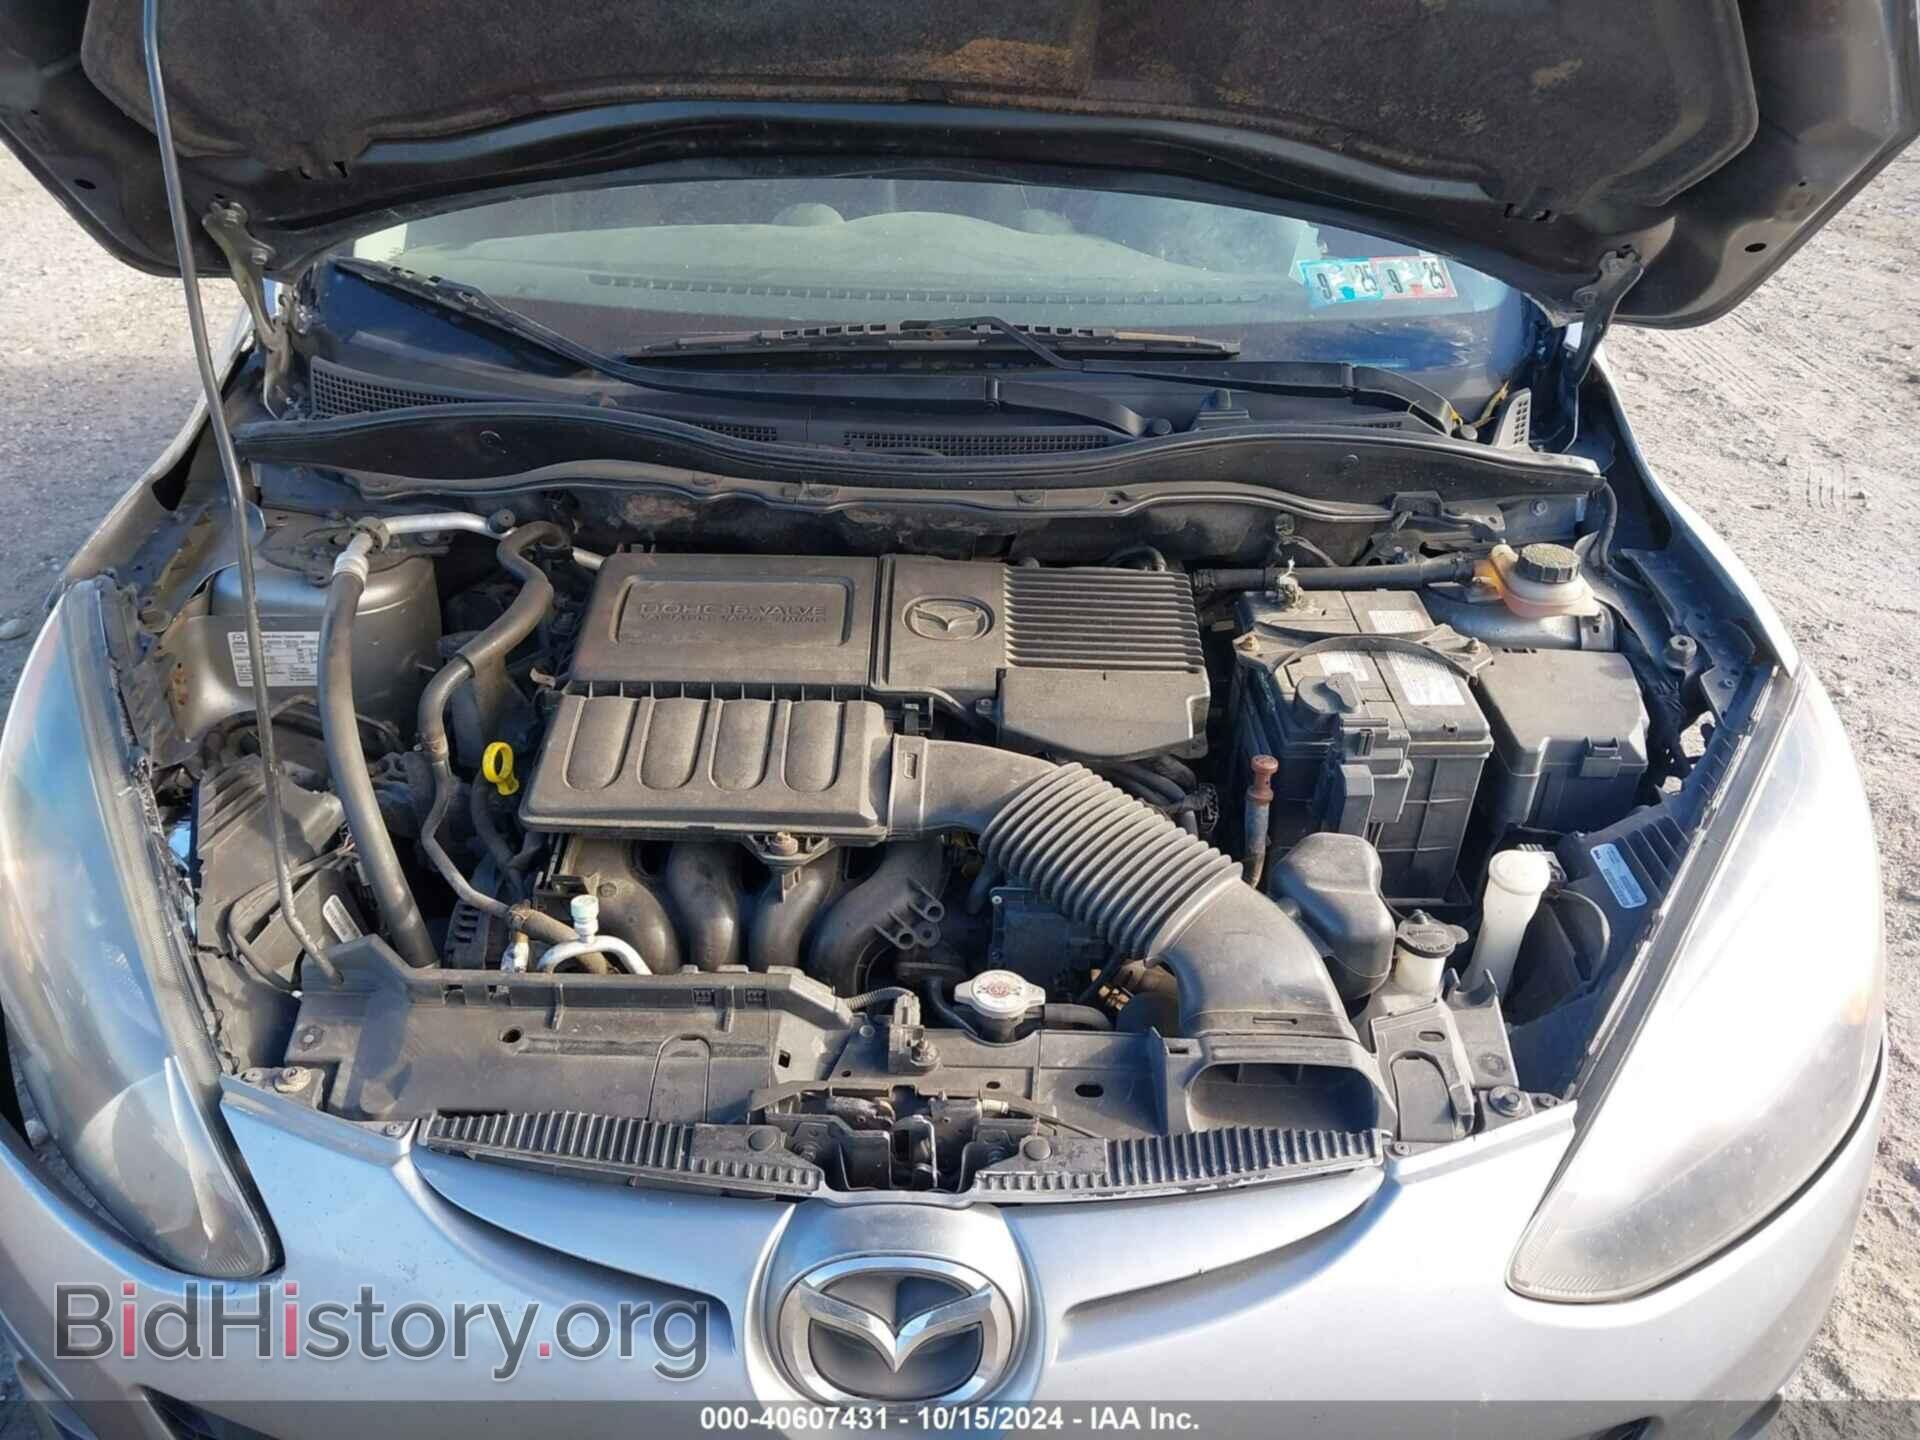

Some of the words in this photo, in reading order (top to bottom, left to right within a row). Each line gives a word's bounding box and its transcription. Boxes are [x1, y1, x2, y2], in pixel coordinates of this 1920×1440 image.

[1316, 272, 1333, 300] 9
[1354, 264, 1379, 293] 25
[1387, 268, 1404, 294] 9
[1422, 260, 1447, 290] 25
[758, 604, 827, 616] VALVE
